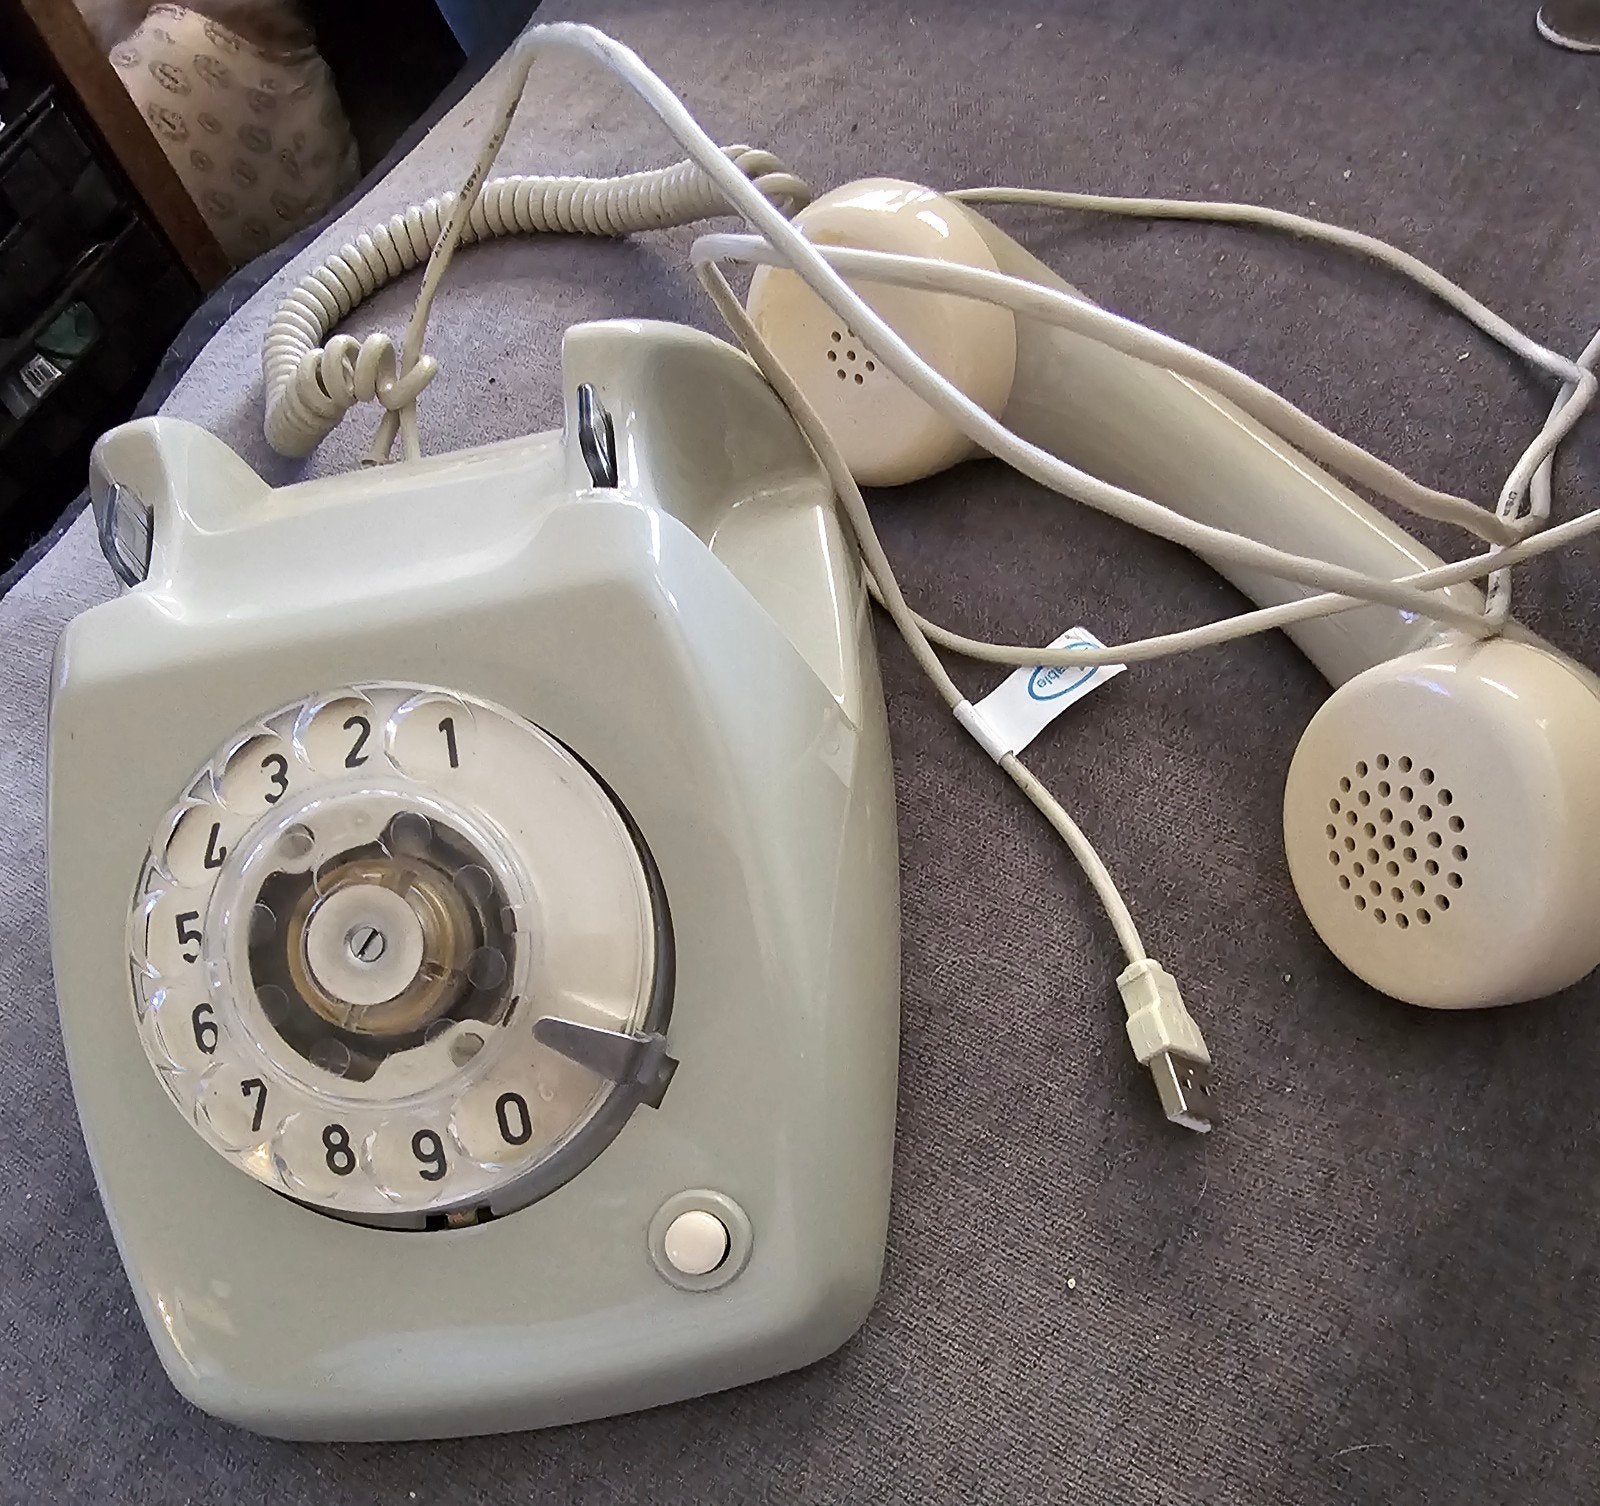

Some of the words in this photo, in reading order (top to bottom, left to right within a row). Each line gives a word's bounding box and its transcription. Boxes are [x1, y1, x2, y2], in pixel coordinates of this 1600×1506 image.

[343, 715, 371, 769] 2
[438, 717, 459, 768] 1
[260, 753, 289, 804] 3
[203, 822, 227, 870] 4
[175, 910, 202, 964] 5
[191, 1002, 219, 1055] 6
[240, 1077, 268, 1133] 7
[495, 1091, 533, 1146] 0
[321, 1123, 357, 1177] 8
[411, 1129, 448, 1182] 9
